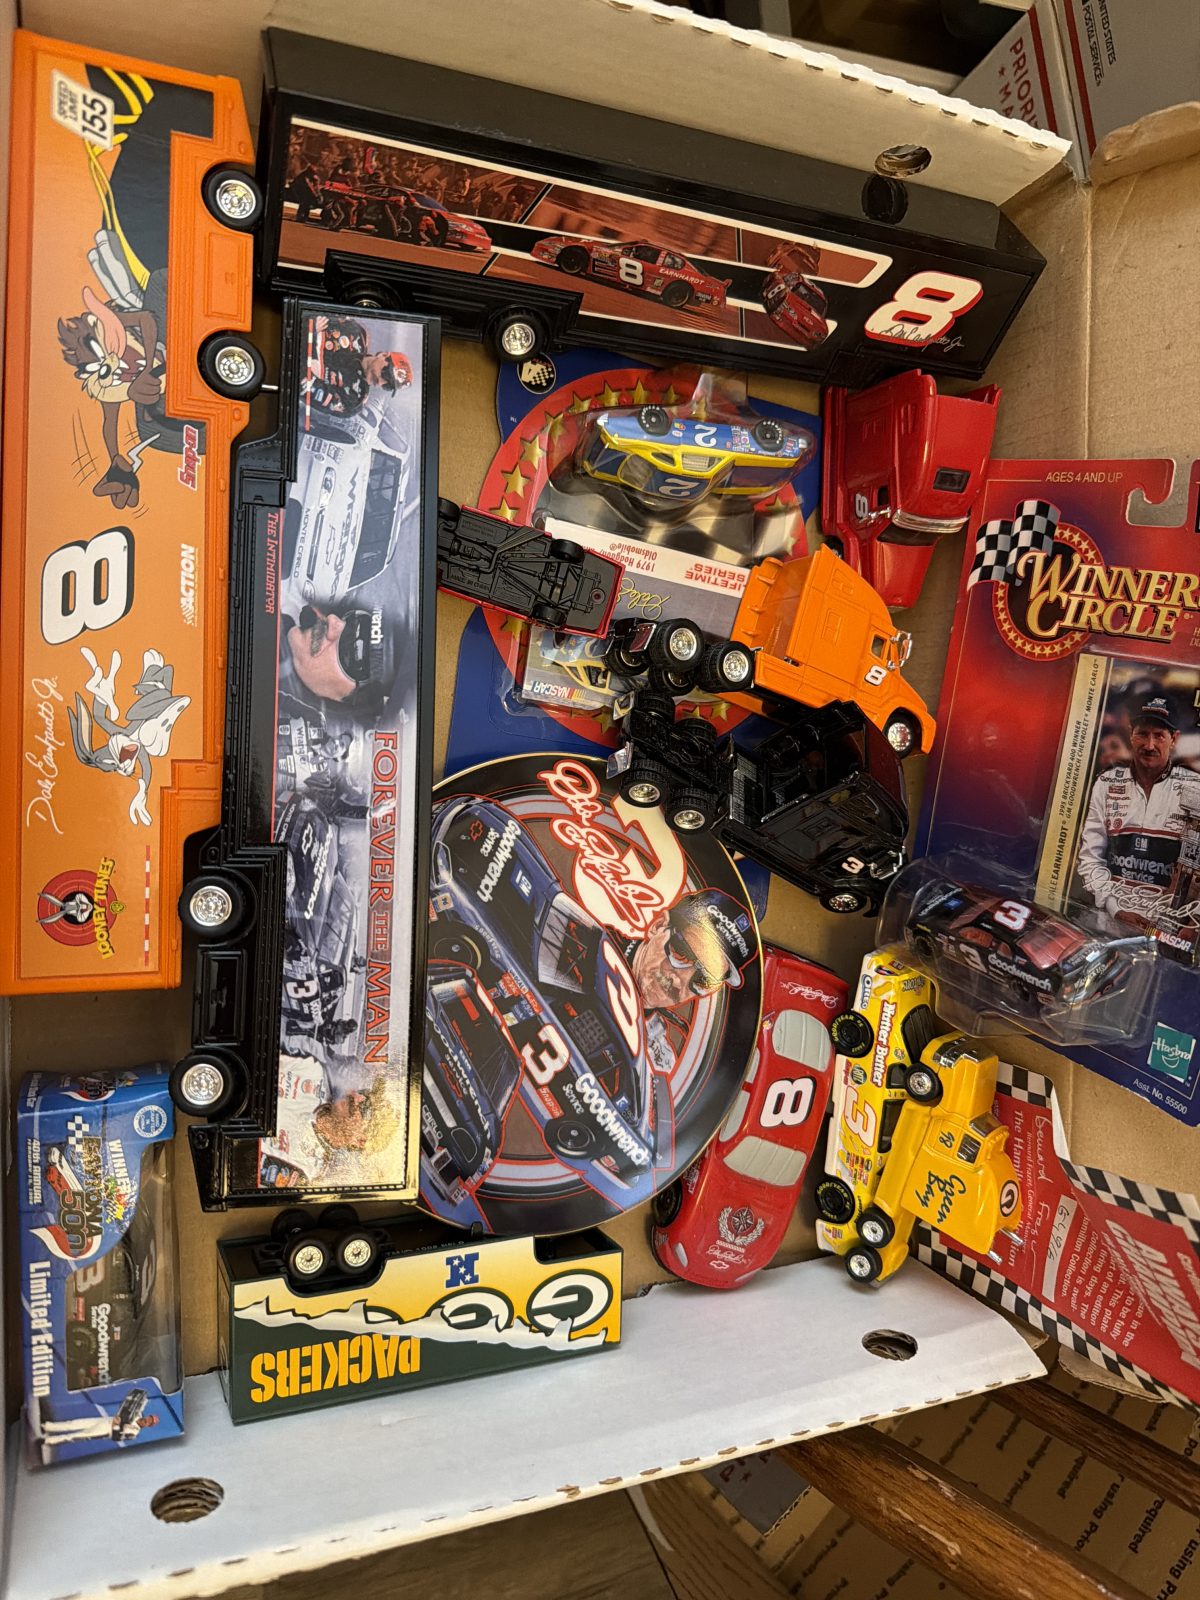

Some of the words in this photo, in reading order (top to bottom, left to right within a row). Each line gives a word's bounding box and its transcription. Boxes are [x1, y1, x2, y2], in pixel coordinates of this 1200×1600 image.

[1099, 0, 1112, 32] NITED
[1082, 4, 1097, 43] POSTAL
[1090, 42, 1102, 86] SERVICE
[1103, 29, 1117, 65] STATES
[82, 94, 107, 140] 155
[618, 256, 644, 286] 8
[659, 267, 705, 286] EARNHARDT
[865, 271, 983, 347] 8
[694, 424, 718, 447] 2
[178, 425, 202, 490] Snap-on
[658, 478, 700, 497] 2
[1045, 471, 1075, 483] AGES
[1082, 472, 1106, 483] AND
[1107, 471, 1123, 482] UP
[180, 543, 196, 609] ACTION
[637, 560, 656, 572] 1979
[1015, 550, 1200, 612] WINNER
[41, 526, 135, 645] 8
[1026, 590, 1182, 643] CIRCLE
[533, 681, 570, 698] NASCAR
[864, 664, 886, 686] 8
[1067, 758, 1082, 806] GOODWRENCH
[1075, 718, 1089, 758] CHEVROLET
[1084, 688, 1096, 712] MONTE
[1071, 720, 1081, 747] WINNER
[1061, 762, 1075, 800] BRICKYARD
[27, 779, 63, 835] Dale
[368, 730, 399, 907] FOREVER
[1059, 801, 1067, 817] 1995
[480, 827, 500, 857] Service
[1051, 826, 1069, 880] EARNHARDT
[477, 819, 521, 903] Goodwrench
[841, 857, 864, 874] 3
[93, 857, 114, 903] TUNES
[92, 905, 115, 960] LOONEY
[371, 911, 391, 951] THE
[706, 904, 750, 959] Goodwrench
[994, 899, 1032, 932] 3
[715, 922, 738, 948] Service
[1158, 931, 1192, 952] NASCAR
[959, 943, 989, 973] 3
[988, 953, 1052, 992] Goodwrench
[860, 975, 874, 1010] OREO
[363, 960, 392, 1064] MAN
[876, 1001, 898, 1042] Nutter
[521, 1023, 571, 1087] 3
[872, 1043, 892, 1088] Butter
[1150, 1036, 1192, 1061] Hasbro
[562, 1083, 584, 1115] Service
[760, 1077, 814, 1128] 8
[845, 1085, 877, 1148] 3
[1165, 1095, 1188, 1115] 55500
[1013, 1110, 1025, 1133] The
[938, 1131, 955, 1149] 98
[108, 1139, 131, 1194] WINNER
[32, 1165, 42, 1204] ANNUAL
[915, 1171, 947, 1208] Bay
[936, 1174, 966, 1225] Green
[60, 1189, 87, 1251] 500
[1026, 1189, 1036, 1219] General
[1077, 1231, 1100, 1275] Collection
[1092, 1248, 1108, 1272] firing
[1056, 1252, 1080, 1298] Collection.
[1074, 1275, 1084, 1286] is
[1082, 1274, 1098, 1300] days.
[1098, 1280, 1110, 1294] an
[1103, 1270, 1114, 1281] of
[29, 1261, 52, 1330] Limited
[1065, 1286, 1082, 1312] avail-
[1077, 1302, 1089, 1319] The
[1086, 1293, 1106, 1326] edition
[1107, 1287, 1121, 1308] This
[1117, 1305, 1129, 1319] be
[1123, 1294, 1134, 1305] to
[1097, 1308, 1114, 1333] plate
[1108, 1318, 1124, 1340] fully
[1129, 1319, 1139, 1330] in
[1121, 1330, 1134, 1348] the
[31, 1332, 53, 1397] Edition
[250, 1334, 421, 1403] PACKERS
[1091, 1480, 1120, 1519] using
[1168, 1536, 1200, 1580] using
